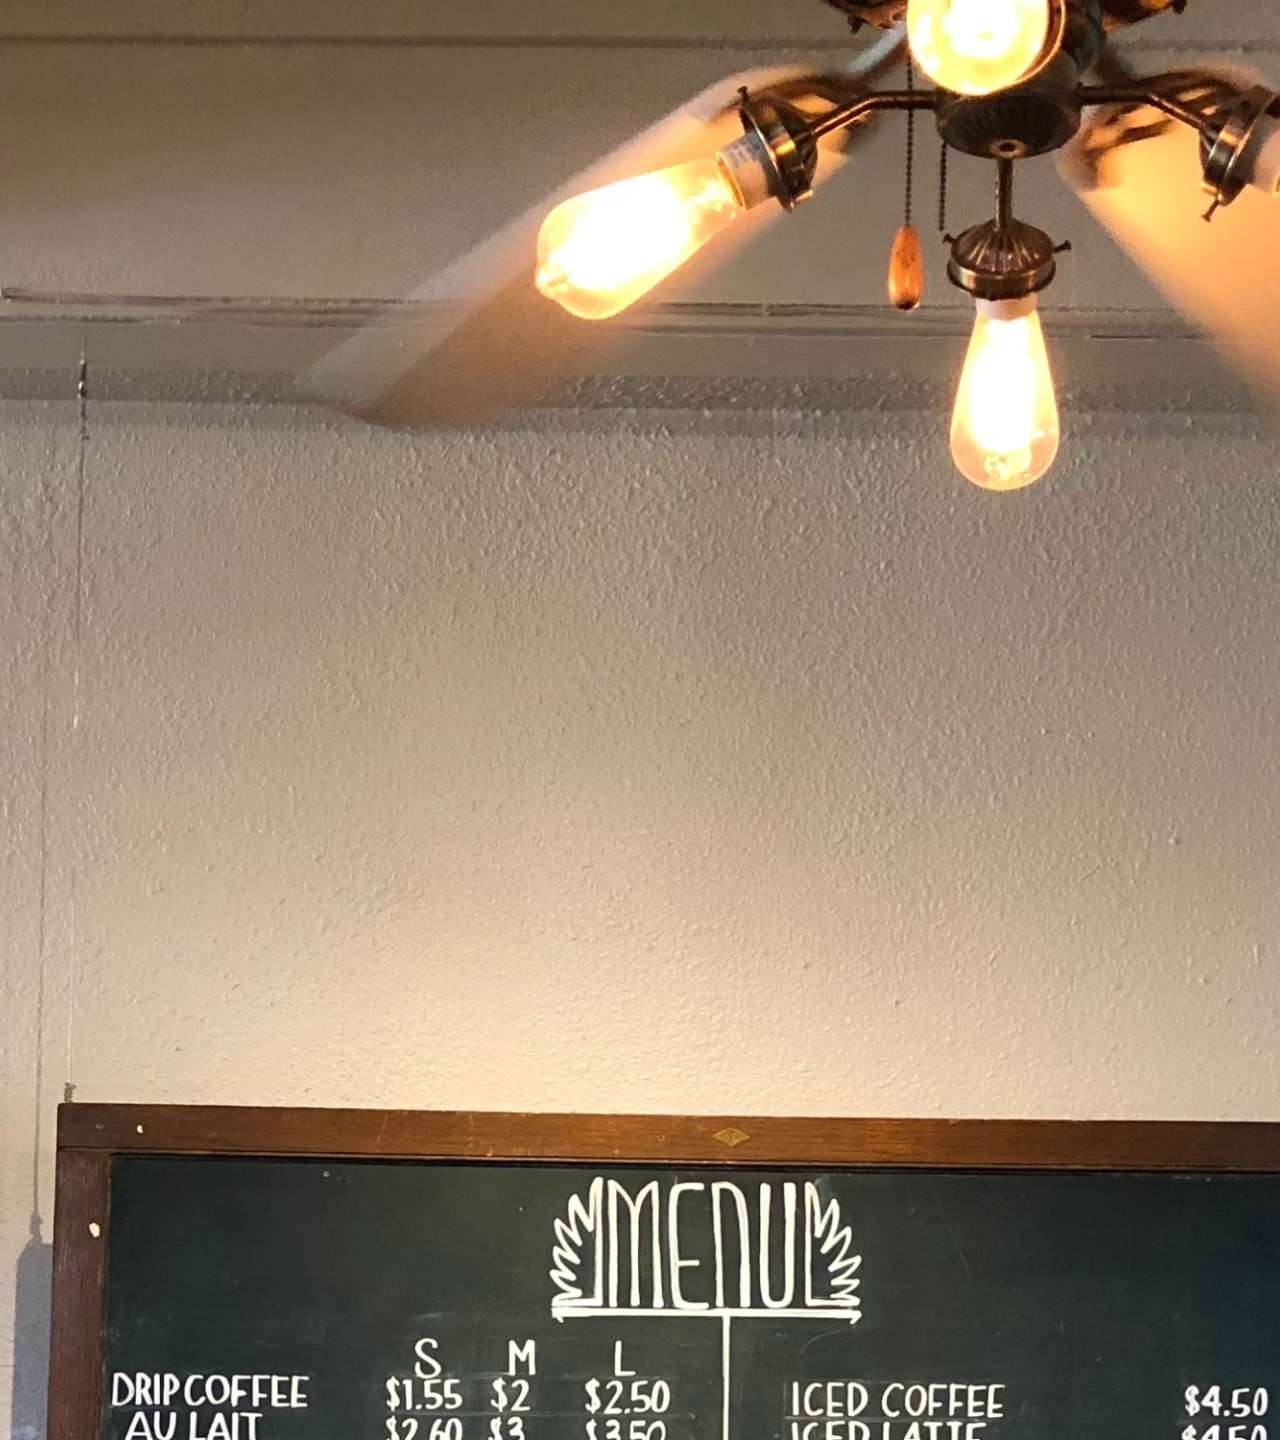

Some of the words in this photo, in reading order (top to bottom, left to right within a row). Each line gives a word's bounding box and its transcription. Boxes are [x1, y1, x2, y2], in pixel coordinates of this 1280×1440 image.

[606, 1179, 797, 1310] MENU
[414, 1337, 442, 1380] S
[507, 1338, 538, 1377] M
[614, 1340, 636, 1377] L
[111, 1371, 181, 1407] DRIP
[183, 1374, 310, 1409] COFFEE
[385, 1375, 463, 1412] $1.55
[490, 1376, 531, 1413] $2
[584, 1377, 671, 1415] $2.50
[792, 1381, 869, 1418] ICED
[881, 1382, 1006, 1419] COFFEE
[1184, 1384, 1269, 1418] $4.50
